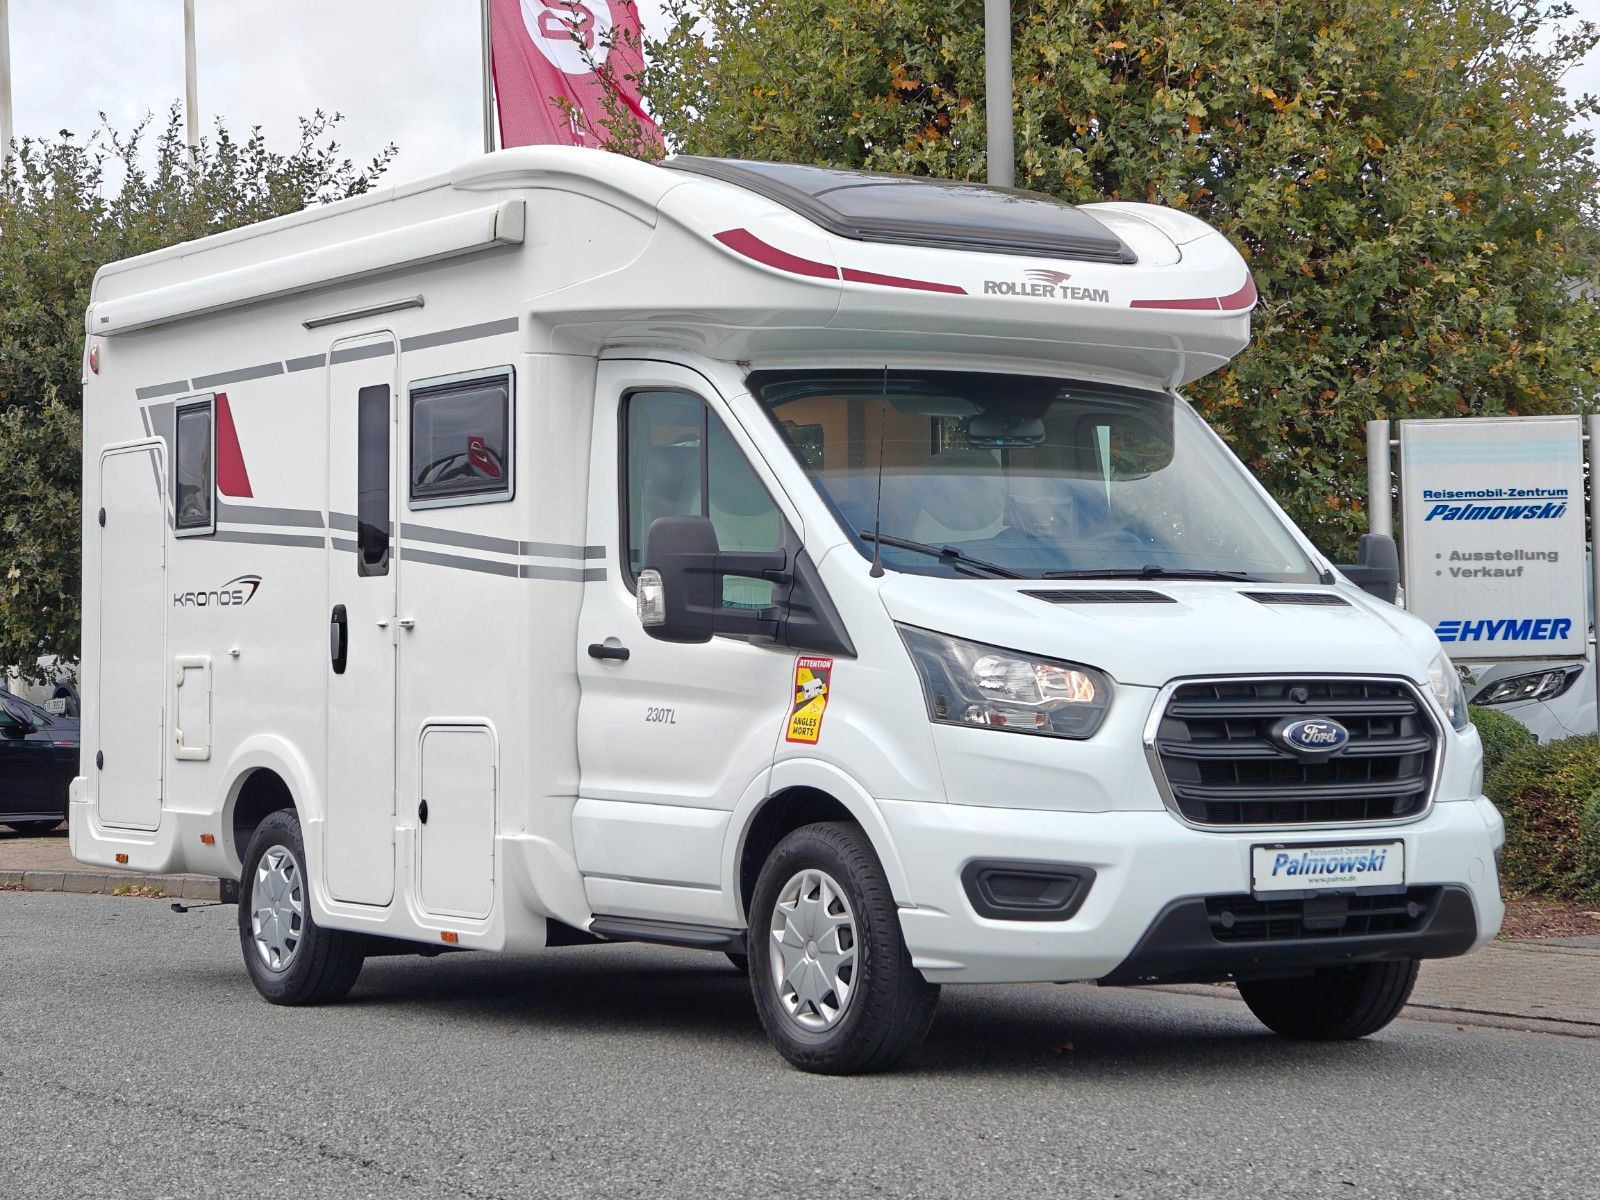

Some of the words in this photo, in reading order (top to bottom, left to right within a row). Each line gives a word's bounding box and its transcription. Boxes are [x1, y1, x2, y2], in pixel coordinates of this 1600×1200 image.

[983, 280, 1056, 298] ROLLER
[1060, 285, 1110, 303] TEAM
[1423, 487, 1568, 499] Reisemobil-Zentrum
[1424, 501, 1568, 521] Palmowski
[1448, 550, 1559, 562] Ausstellung
[1448, 566, 1524, 578] Verkauf
[173, 590, 243, 607] KRONOS
[1458, 618, 1572, 641] HYMER
[799, 659, 831, 669] ATTENTION
[645, 706, 676, 724] 230TL
[793, 717, 817, 727] ANGLES
[792, 726, 814, 736] MORTS
[1301, 724, 1338, 743] Ford
[1271, 848, 1388, 877] Palmowski
